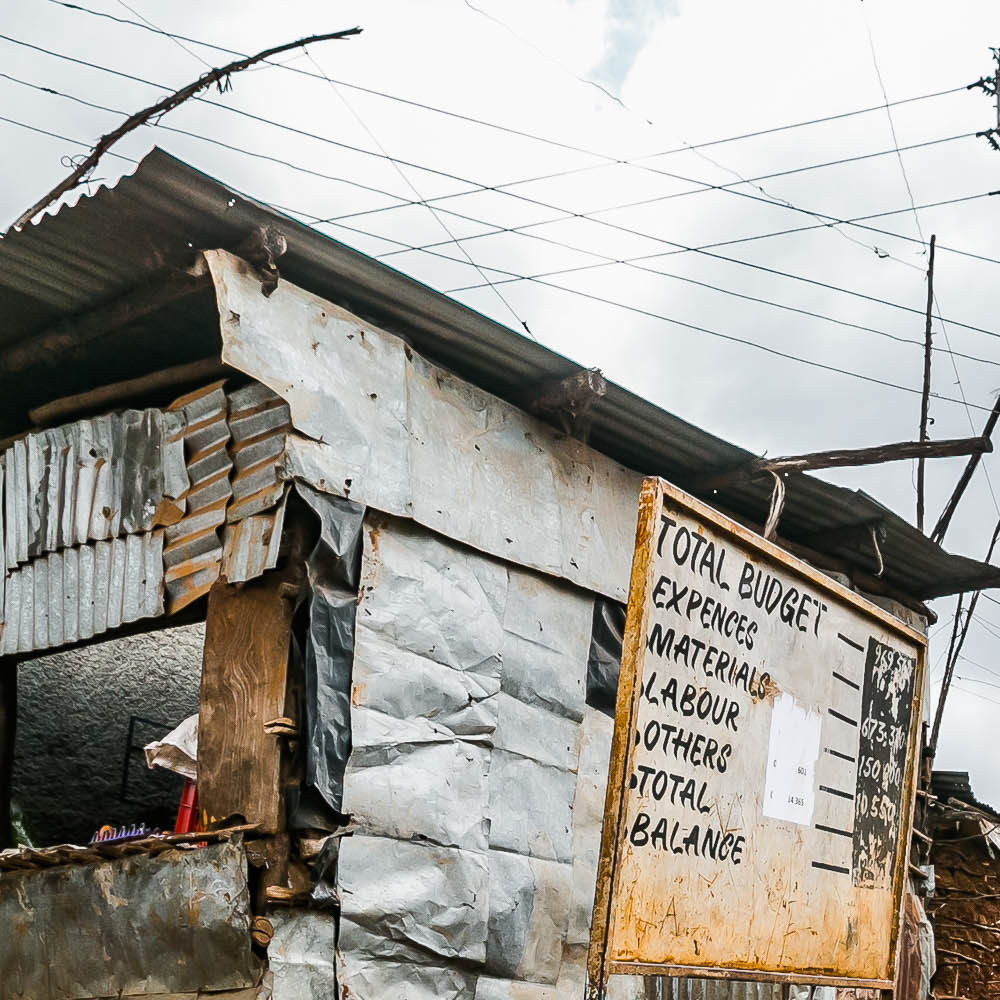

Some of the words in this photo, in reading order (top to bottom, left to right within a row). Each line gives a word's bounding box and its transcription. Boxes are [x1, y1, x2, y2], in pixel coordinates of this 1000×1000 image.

[656, 514, 730, 592] TOTAL
[738, 562, 828, 640] BUDGET
[653, 575, 758, 651] EXPENCES
[649, 623, 771, 700] MATERIALS
[645, 671, 740, 732] LABOUR
[643, 719, 732, 774] OTHERS
[637, 764, 711, 814] TOTAL
[629, 812, 746, 865] BALANCE
